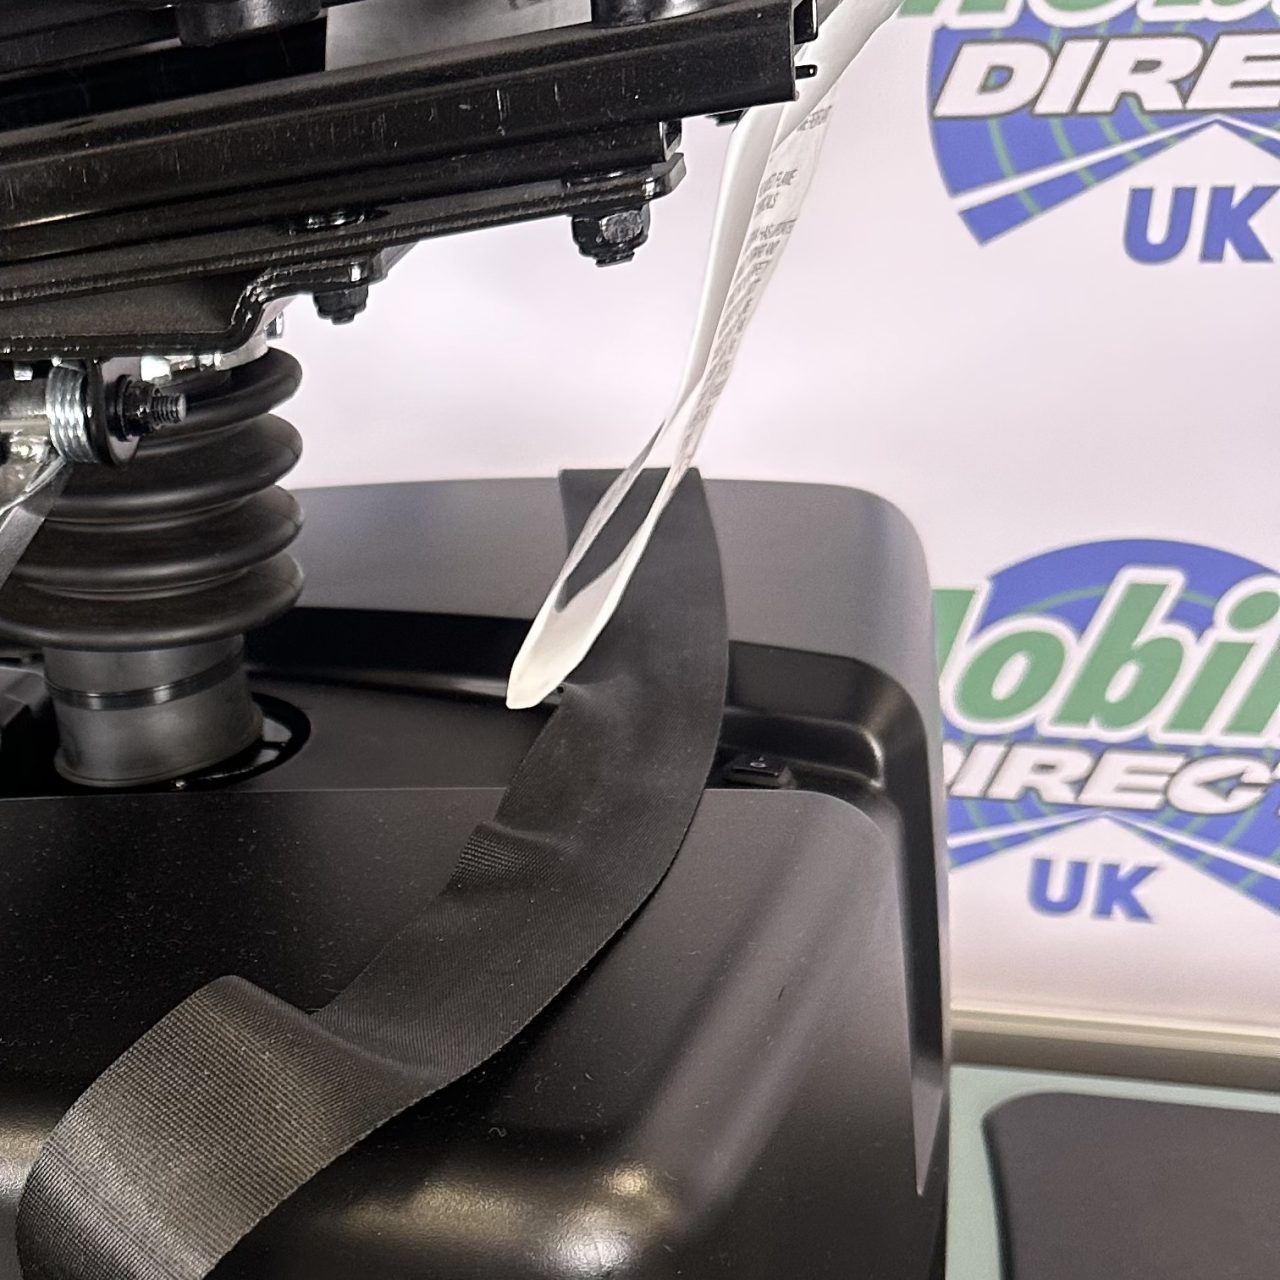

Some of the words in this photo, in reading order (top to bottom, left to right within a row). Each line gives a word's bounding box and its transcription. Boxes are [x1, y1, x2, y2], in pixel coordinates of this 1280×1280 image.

[1123, 185, 1280, 266] UK
[942, 740, 1280, 816] IREC
[1029, 856, 1158, 924] UK
